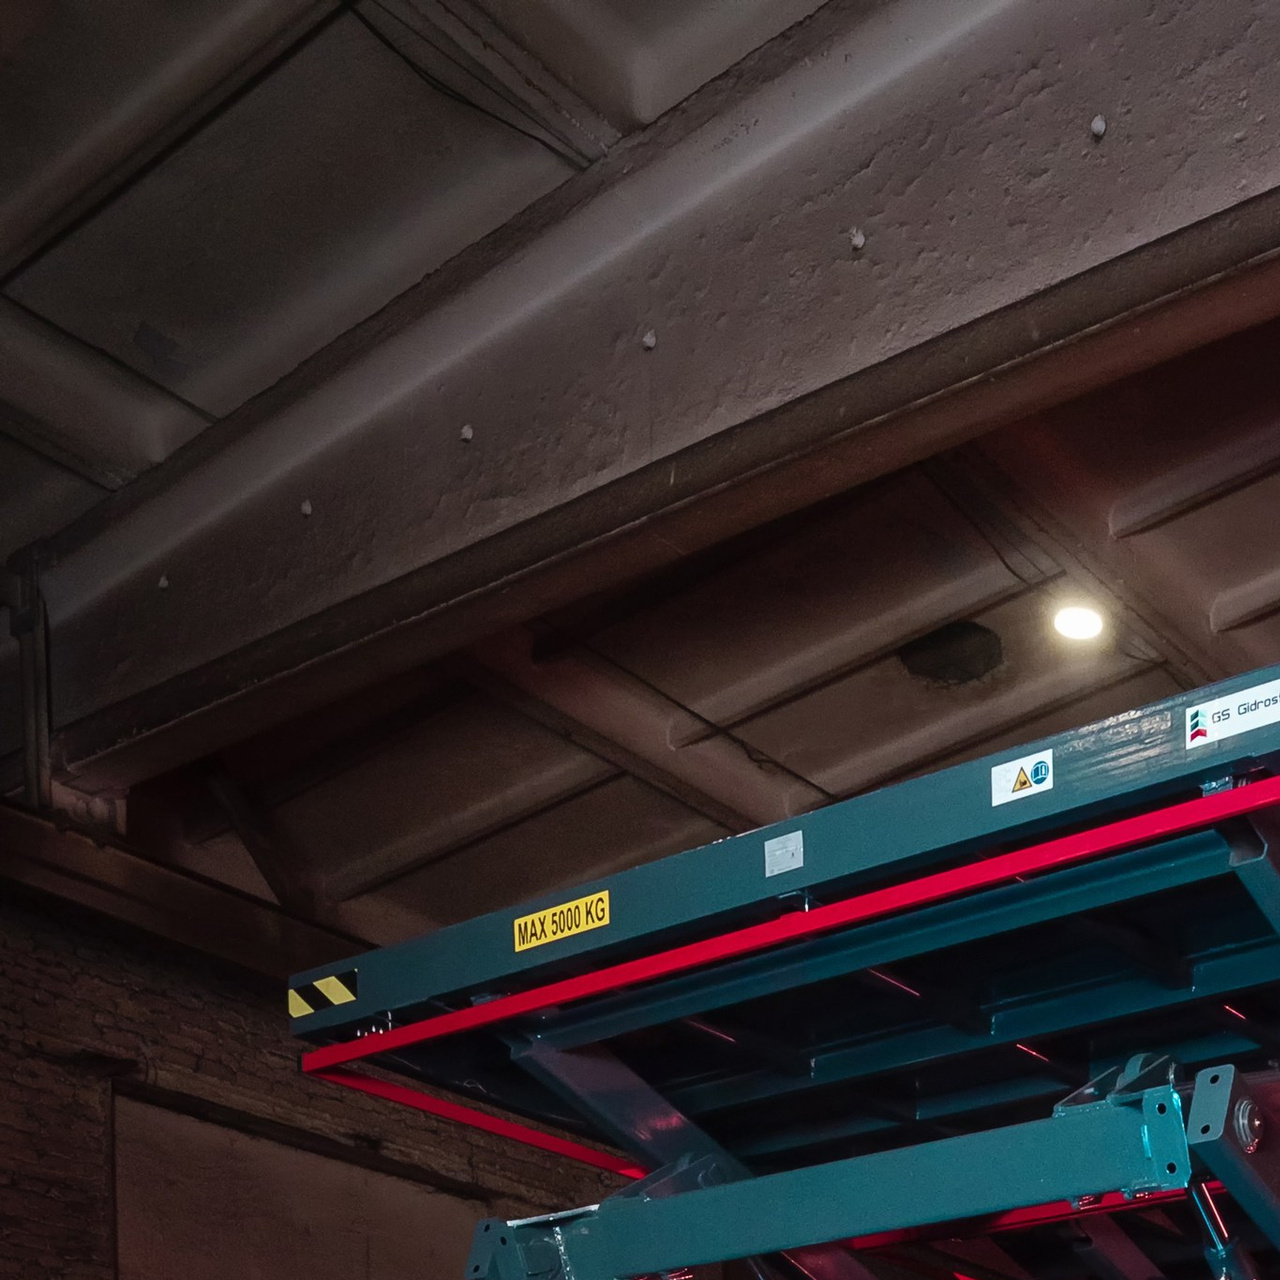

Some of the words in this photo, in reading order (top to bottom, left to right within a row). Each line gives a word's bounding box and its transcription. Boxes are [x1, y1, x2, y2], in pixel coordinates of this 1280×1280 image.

[1211, 708, 1231, 724] GS
[518, 915, 548, 947] MAX
[551, 904, 581, 936] 5000
[585, 897, 606, 926] KG
